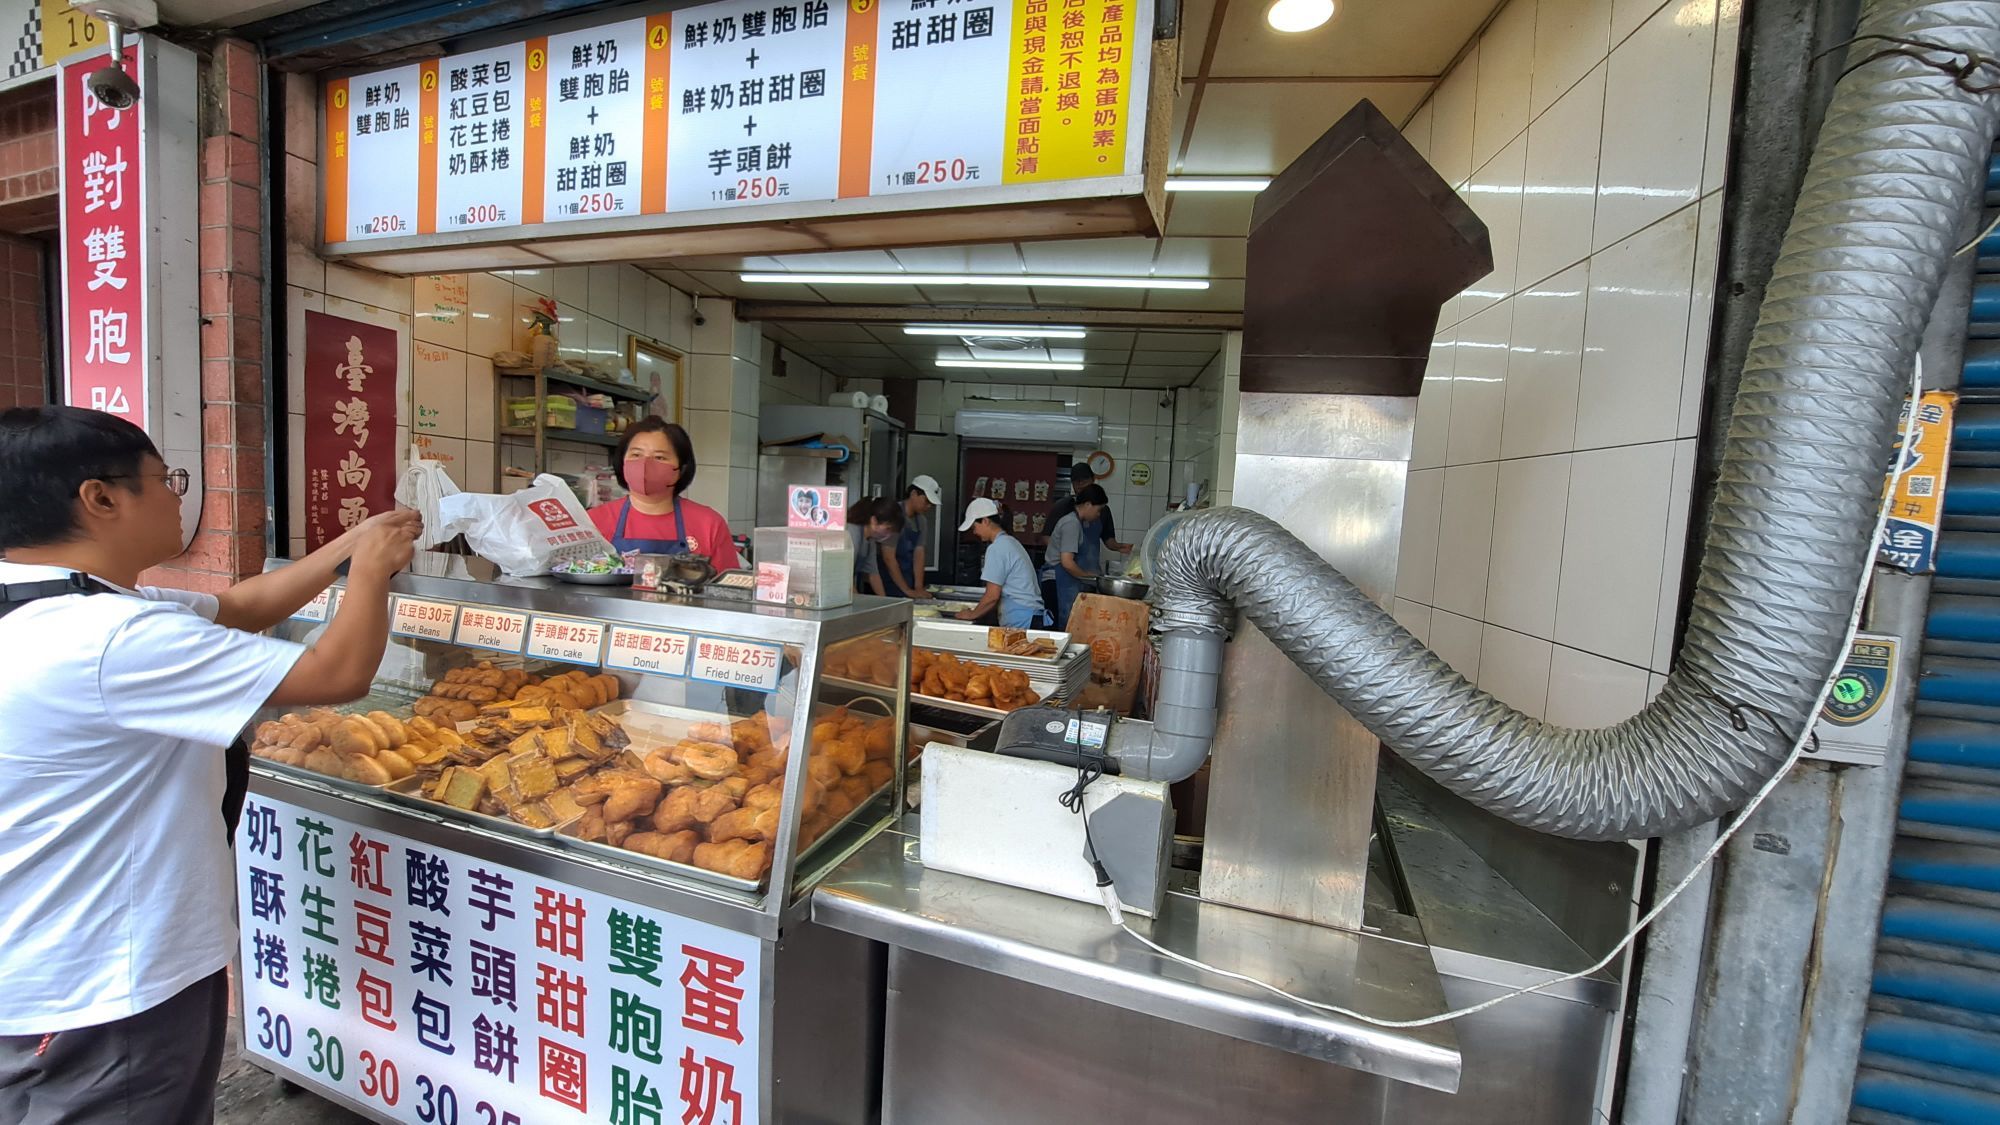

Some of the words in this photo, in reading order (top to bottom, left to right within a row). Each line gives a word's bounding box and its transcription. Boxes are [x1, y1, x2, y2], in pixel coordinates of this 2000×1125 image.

[68, 14, 96, 48] 16
[684, 0, 829, 49] 鮮奶雙胞胎
[891, 6, 994, 50] 甜甜圈
[571, 39, 618, 70] 鮮奶
[745, 48, 760, 69] +
[450, 60, 511, 93] 酸菜包
[559, 68, 630, 103] 雙胞胎
[682, 68, 826, 115] 鮮奶甜甜圈
[1015, 0, 1049, 175] 品與現金請當面點清
[1093, 0, 1124, 163] 產品均為蛋奶素。
[365, 82, 400, 108] 鮮奶
[449, 90, 511, 120] 紅豆包
[356, 107, 410, 136] 雙胞胎
[587, 106, 599, 125] +
[743, 115, 758, 136] +
[449, 117, 511, 148] 花生捲
[569, 132, 615, 161] 鮮奶
[448, 146, 510, 176] 奶酥捲
[707, 142, 792, 176] 芋頭餅
[886, 158, 980, 186] 11個250元
[556, 161, 627, 192] 甜甜圈
[711, 176, 790, 201] 11個250元
[449, 204, 506, 225] 11個300元
[557, 192, 624, 215] 11個250元
[355, 215, 406, 234] 11個250元
[397, 603, 452, 624] 紅豆包30元
[462, 611, 523, 634] 酸菜包30元
[402, 622, 416, 634] Red
[418, 625, 441, 637] Beans
[478, 634, 501, 646] Pickle
[534, 622, 599, 645] 芋頭餅25元
[613, 631, 686, 656] 甜甜圈25元
[542, 645, 560, 656] Taro
[563, 648, 583, 659] cake
[633, 656, 660, 670] Donut
[697, 642, 777, 669] 雙胞胎25元
[705, 666, 730, 680] Fried
[734, 670, 763, 685] bread
[246, 801, 290, 989] 奶酥捲
[296, 816, 341, 1011] 花生捲
[348, 831, 398, 1033] 紅豆包
[405, 847, 456, 1056] 酸菜包
[467, 867, 520, 1084] 芋頭餅
[534, 885, 588, 1114] 甜甜圈
[606, 906, 664, 1125] 雙胞胎
[257, 1005, 293, 1058] 30
[678, 943, 746, 1125] 蛋奶
[306, 1027, 345, 1082] 30
[358, 1049, 400, 1107] 30
[415, 1074, 458, 1125] 30
